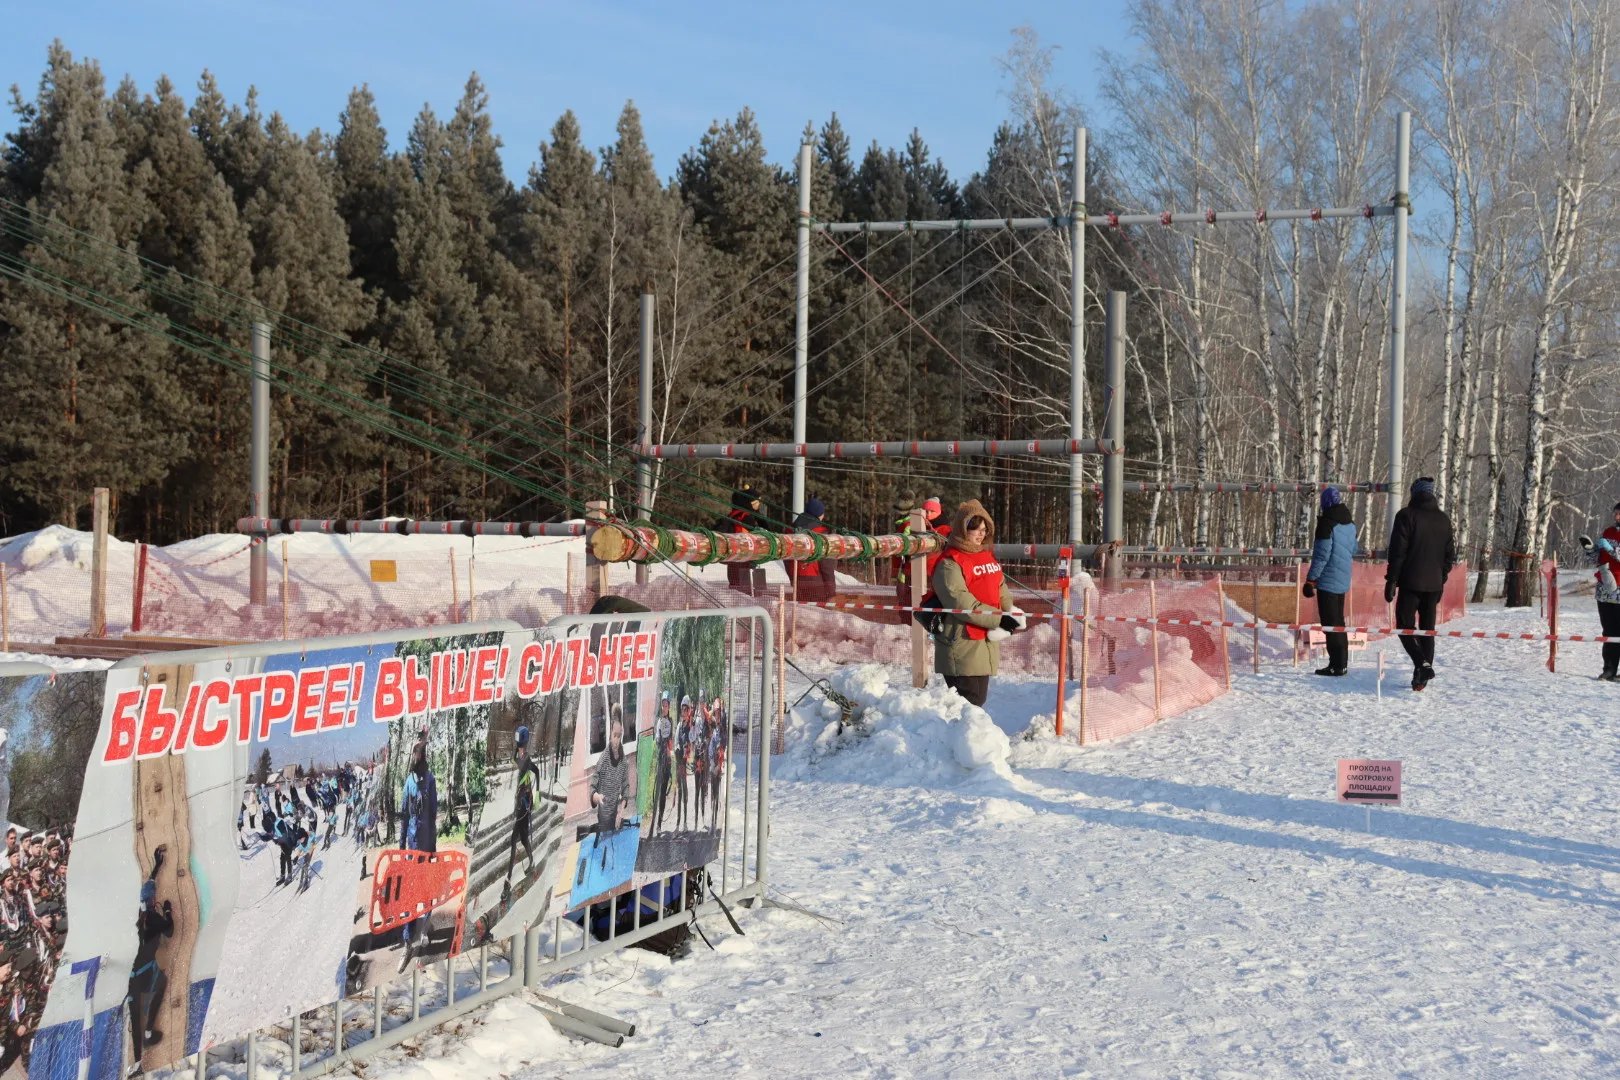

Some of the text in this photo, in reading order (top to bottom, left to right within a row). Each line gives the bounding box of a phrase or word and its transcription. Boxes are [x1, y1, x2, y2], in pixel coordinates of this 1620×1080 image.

[103, 632, 658, 764] БЫСТРЕЕ! ВЫШЕ! СИЛЬНЕЕ!
[1349, 765, 1380, 773] ПРОХОД
[1346, 774, 1394, 782] СМОТРОВУЮ
[1348, 783, 1392, 792] ПЛОЩАДКУ
